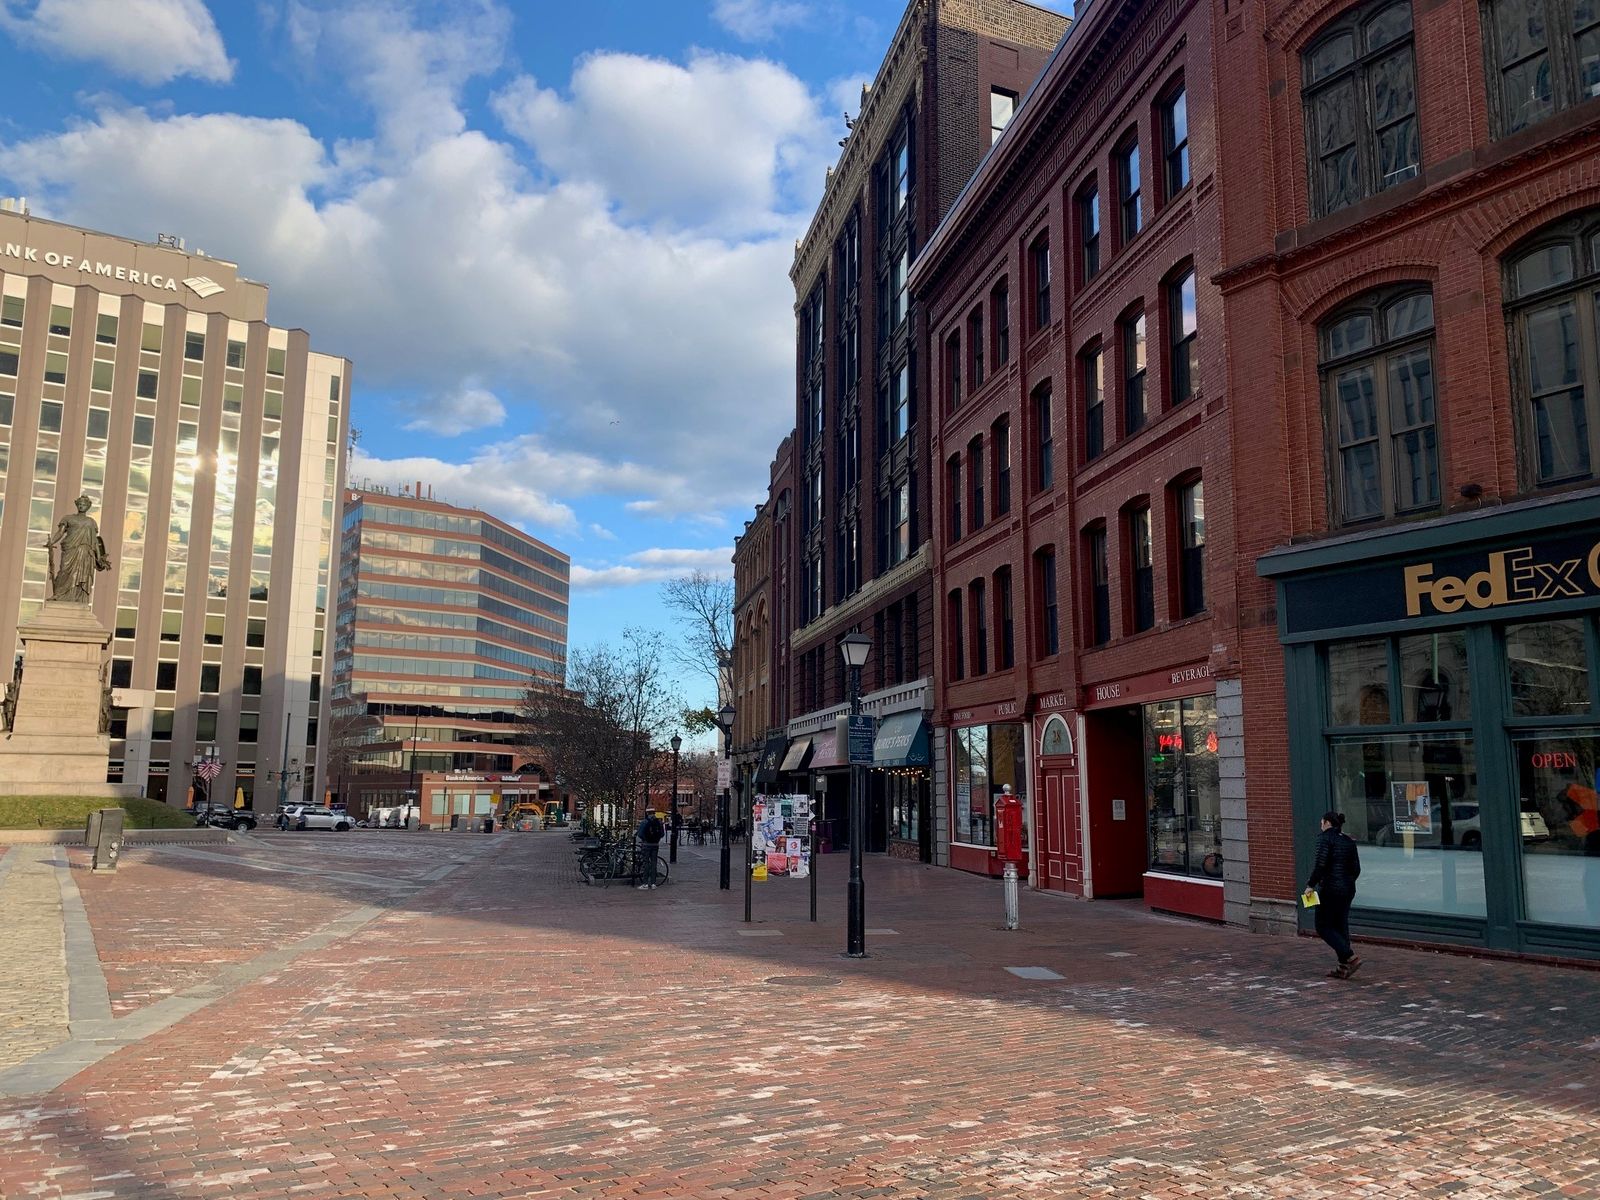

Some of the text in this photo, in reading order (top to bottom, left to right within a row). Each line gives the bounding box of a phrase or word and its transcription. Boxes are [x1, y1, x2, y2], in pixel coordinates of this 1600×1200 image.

[0, 243, 177, 291] NK OF AMERICA
[1404, 546, 1585, 616] FedEx
[1096, 684, 1120, 701] HOUSE
[998, 702, 1017, 716] PUBLIC
[1532, 752, 1577, 768] OPEN
